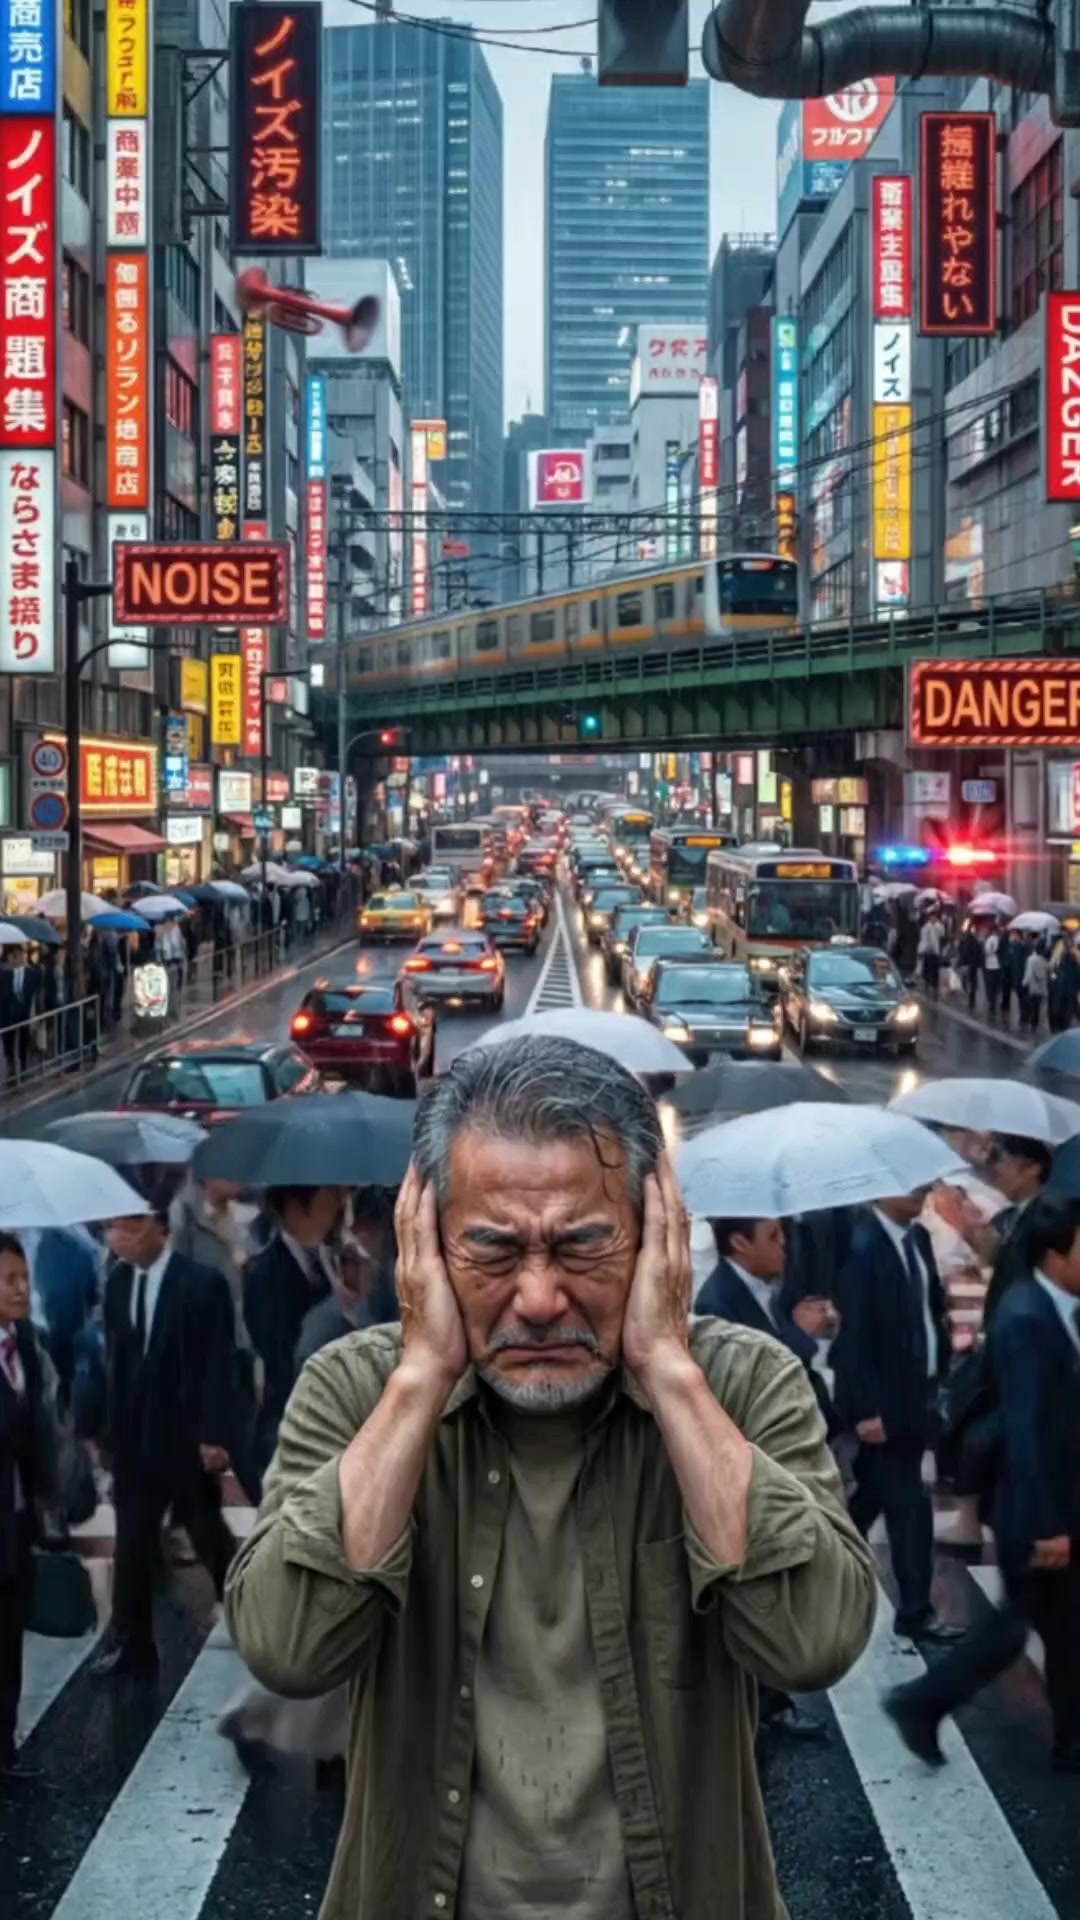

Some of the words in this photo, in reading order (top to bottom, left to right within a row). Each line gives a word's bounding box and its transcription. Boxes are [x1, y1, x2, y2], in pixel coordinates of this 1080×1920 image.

[250, 16, 303, 237] ノイズ汚染
[5, 131, 47, 432] ノイズ商題集
[882, 332, 902, 398] ノイズ
[132, 561, 271, 606] NOISE
